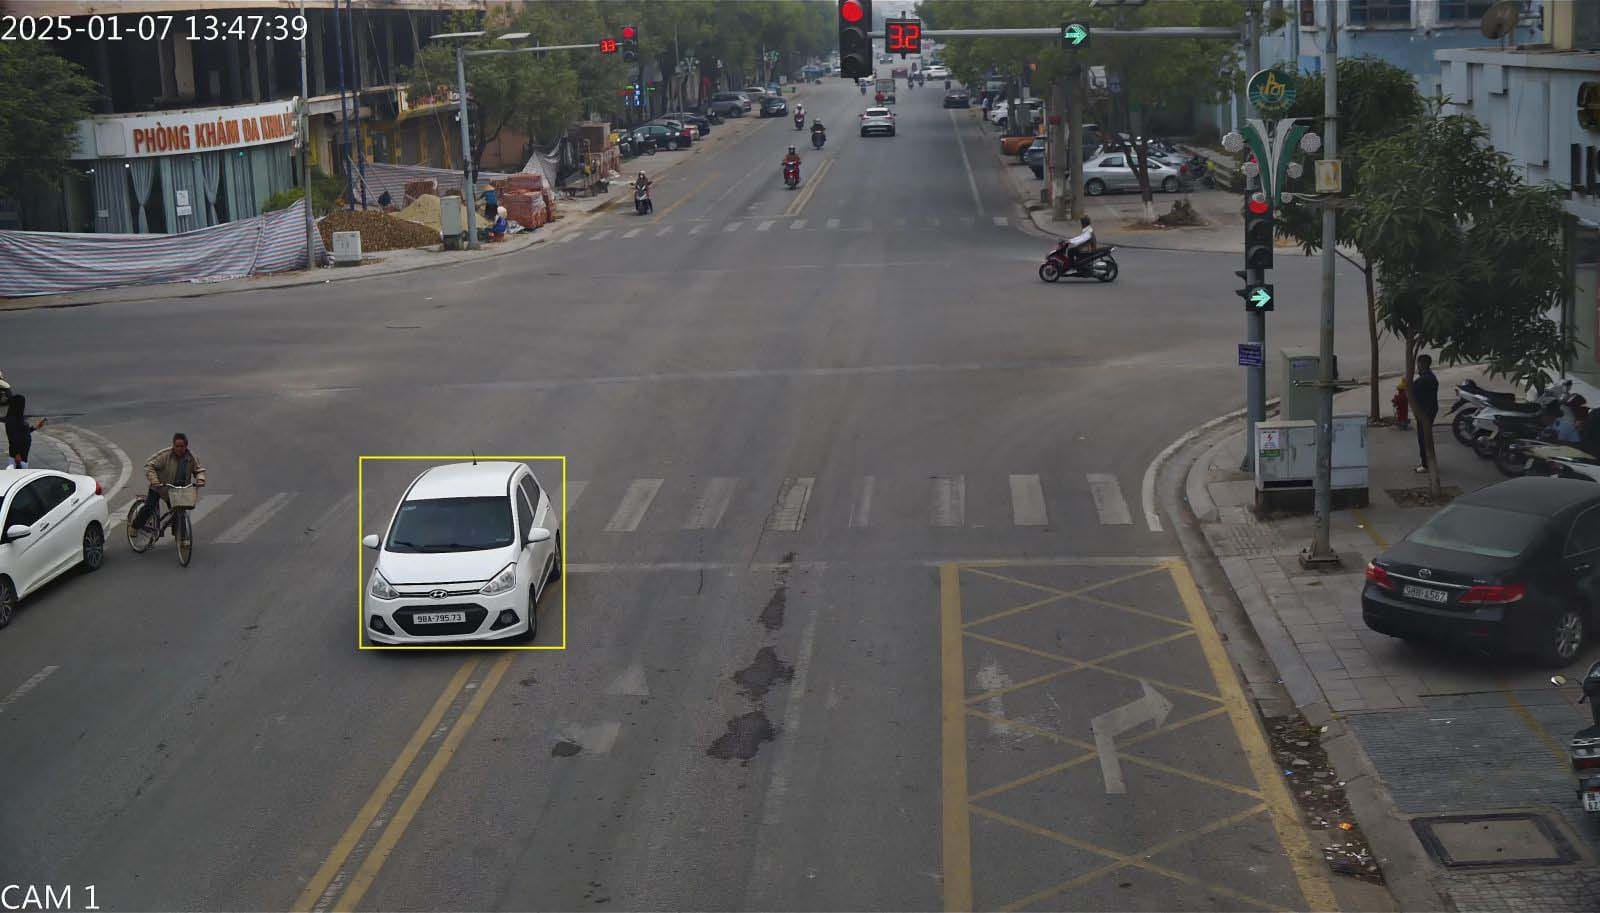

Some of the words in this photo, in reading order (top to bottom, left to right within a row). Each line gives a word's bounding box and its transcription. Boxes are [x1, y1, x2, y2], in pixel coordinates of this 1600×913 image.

[889, 24, 920, 49] 32
[133, 122, 191, 153] PHÒNG
[195, 116, 240, 148] KHÁM
